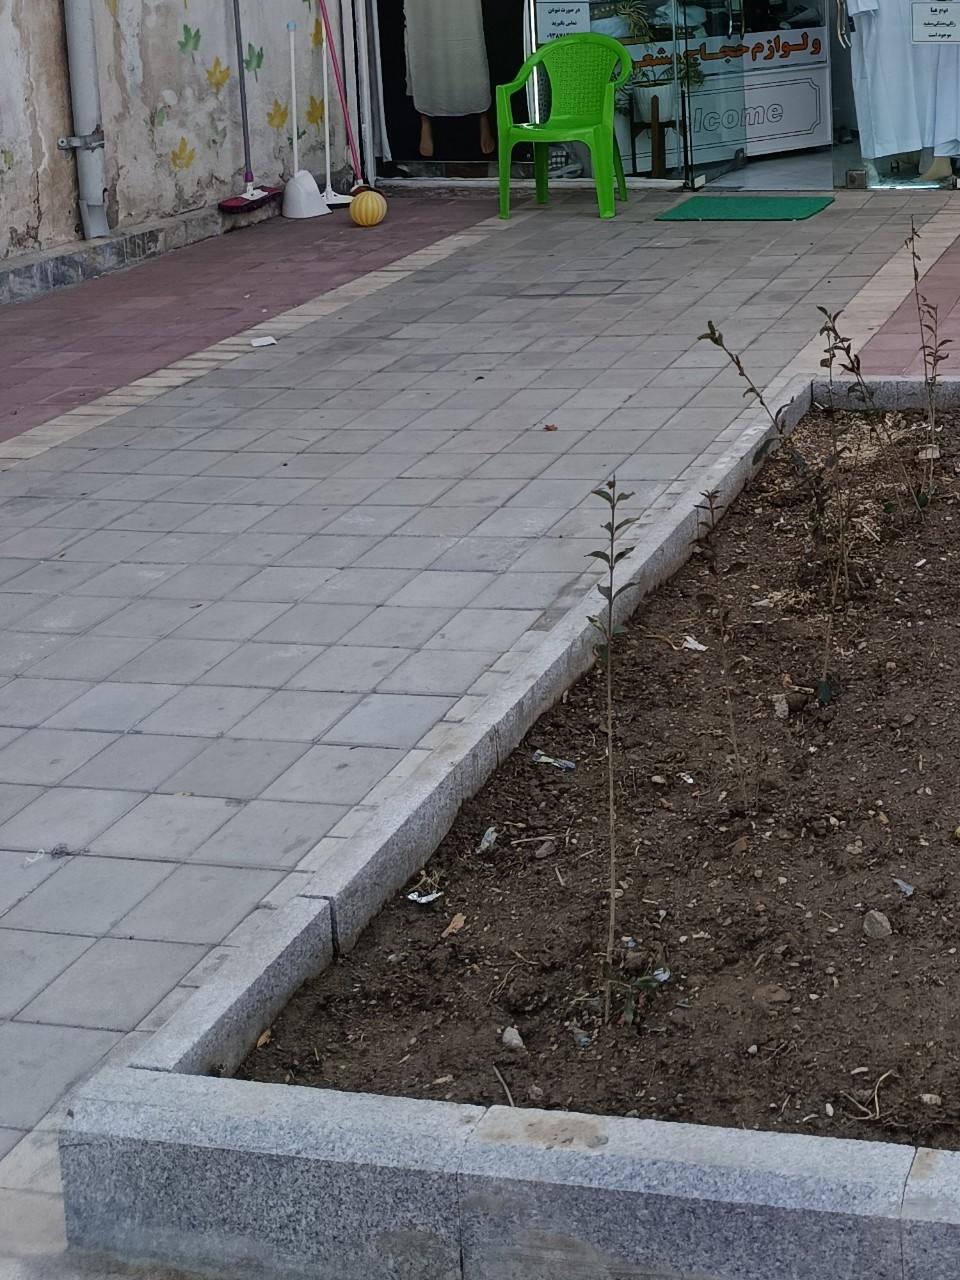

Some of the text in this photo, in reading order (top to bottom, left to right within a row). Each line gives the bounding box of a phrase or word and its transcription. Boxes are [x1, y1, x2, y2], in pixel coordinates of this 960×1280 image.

[684, 41, 751, 64] حجاج
[751, 31, 809, 62] لوازم
[810, 37, 822, 55] و
[693, 103, 784, 134] lcome
